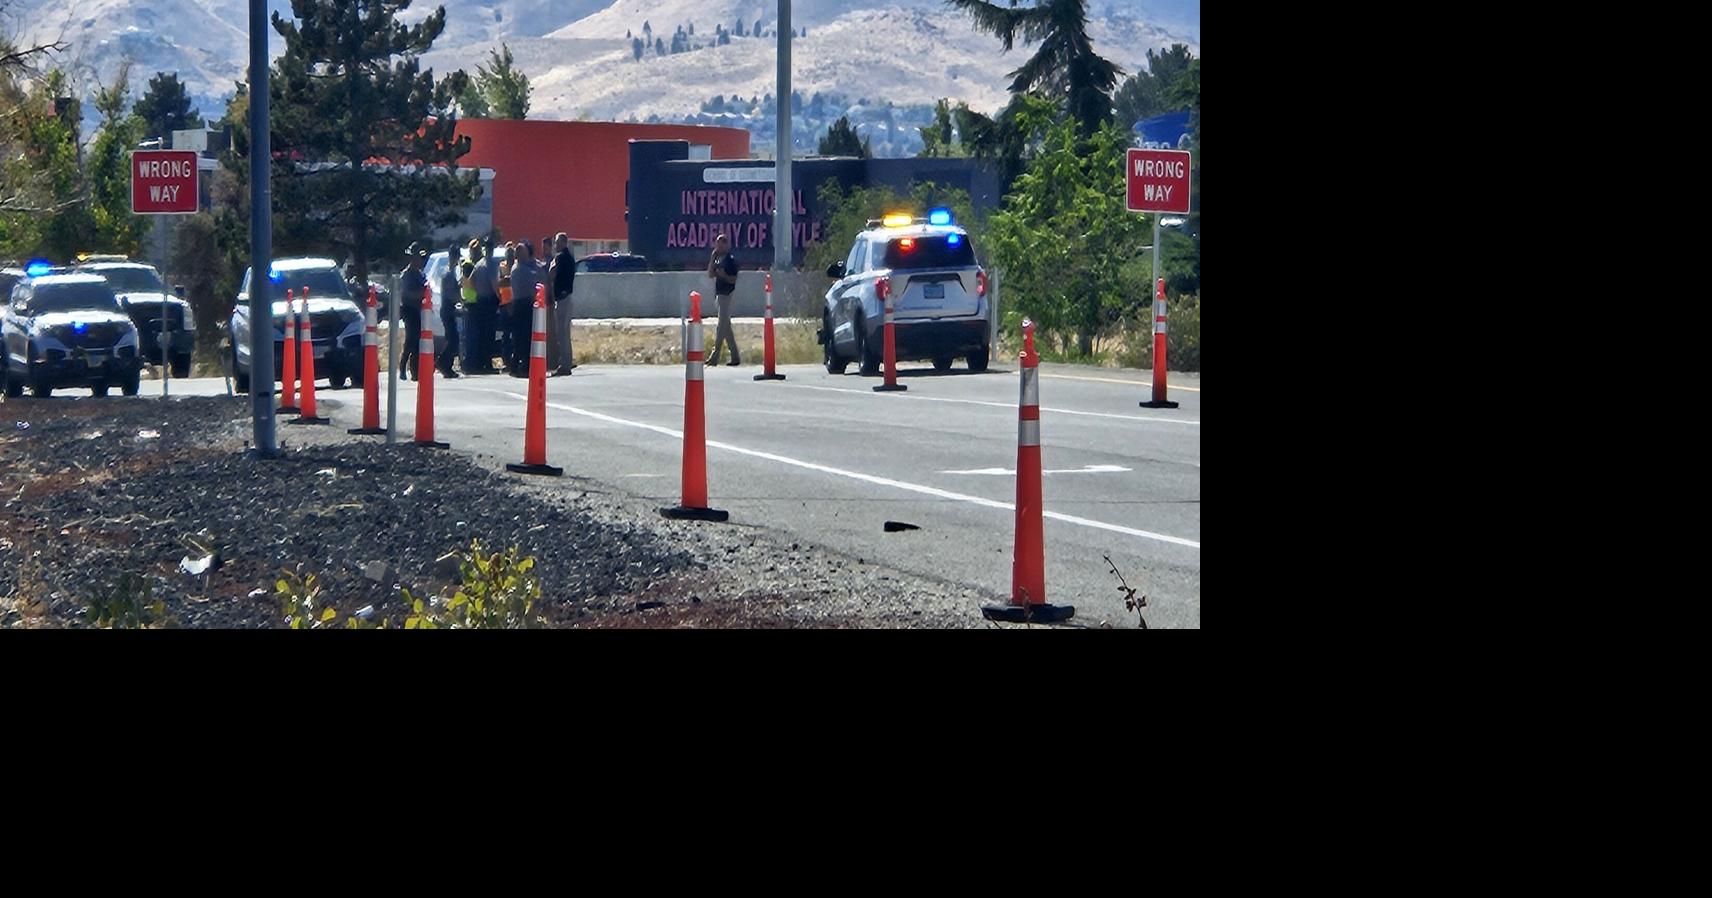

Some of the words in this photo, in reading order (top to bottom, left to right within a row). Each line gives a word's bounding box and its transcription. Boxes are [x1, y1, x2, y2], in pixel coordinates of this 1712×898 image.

[139, 160, 191, 178] WRONG
[1134, 159, 1184, 179] WRONG
[149, 185, 180, 203] WAY
[681, 189, 806, 215] INTERNATIOL
[1143, 184, 1173, 202] WAY
[747, 222, 767, 248] OF
[773, 221, 820, 248] YLE
